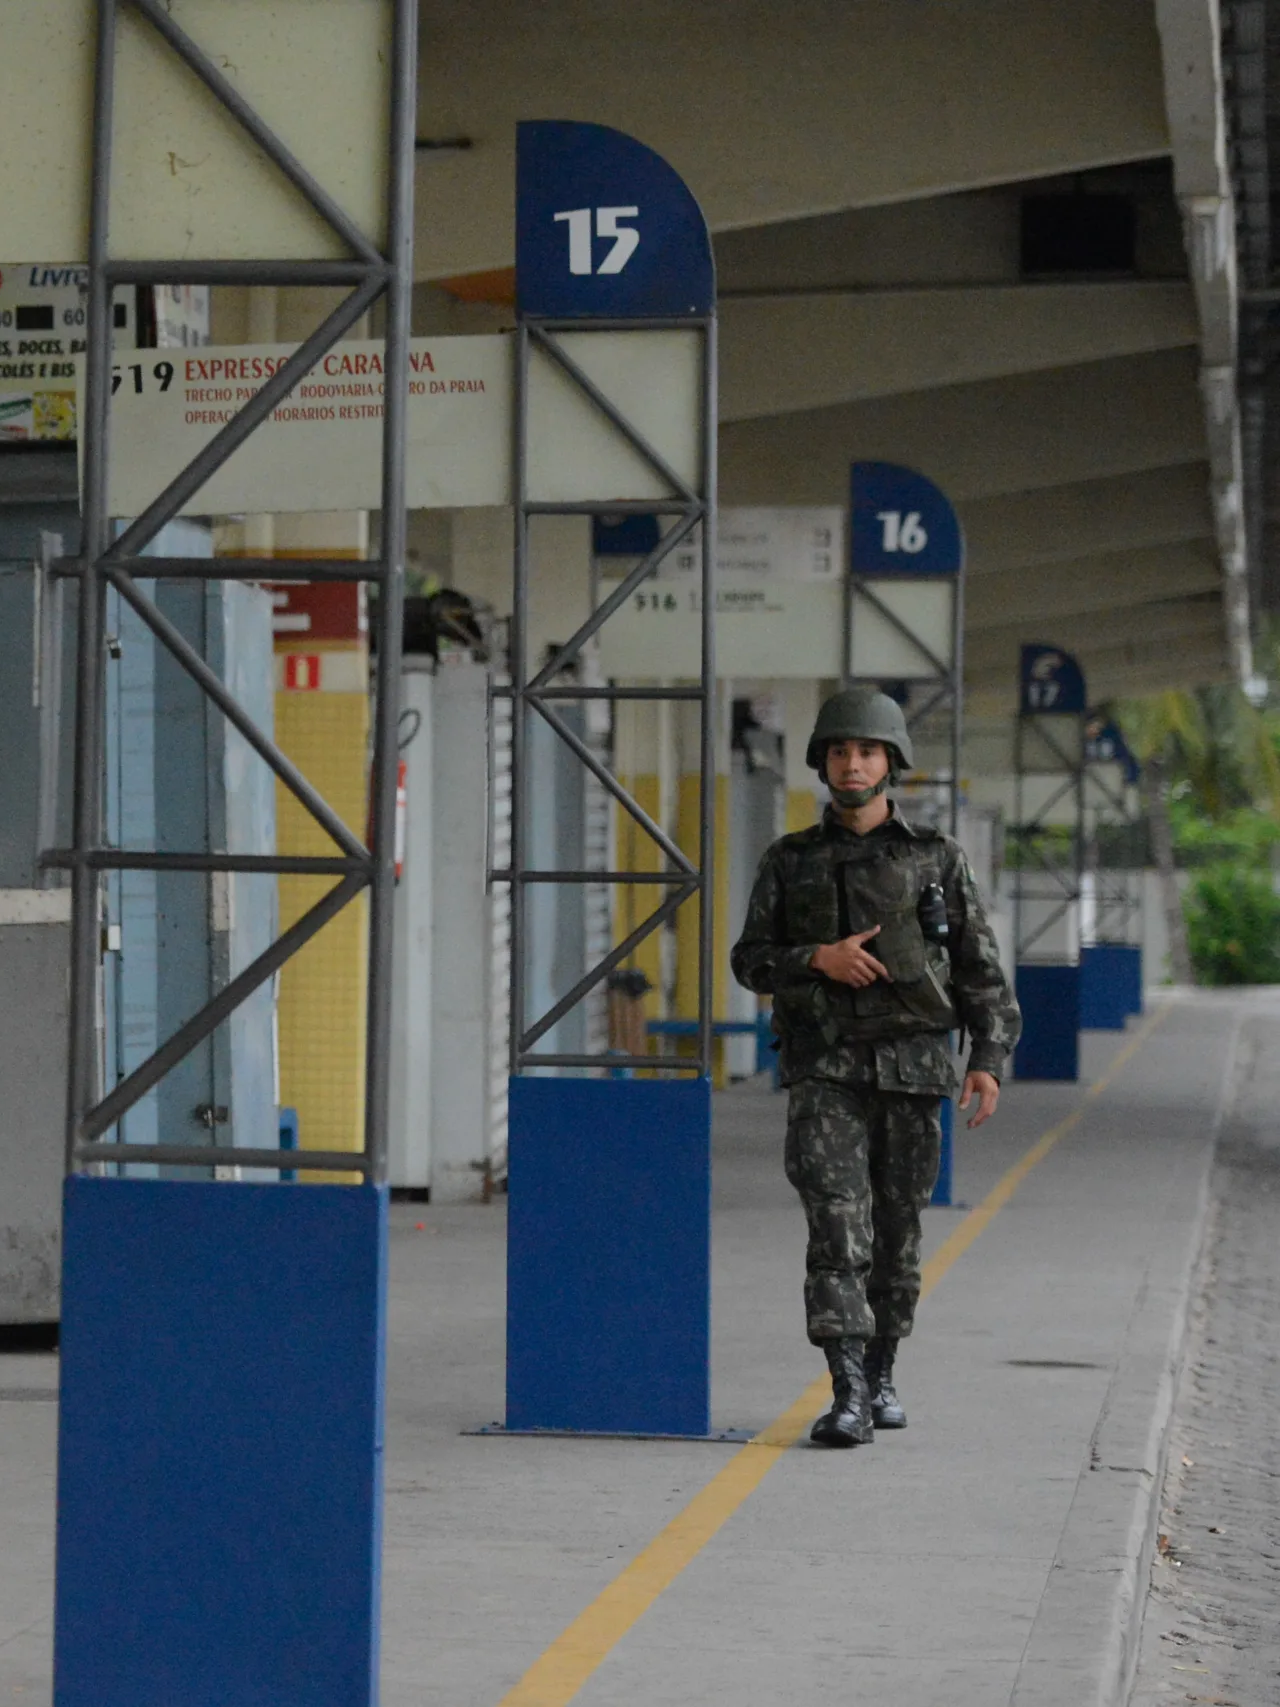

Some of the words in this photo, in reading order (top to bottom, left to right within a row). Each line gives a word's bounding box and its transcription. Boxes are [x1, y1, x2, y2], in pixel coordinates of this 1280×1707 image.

[553, 206, 640, 275] 15
[63, 307, 85, 326] 60
[324, 352, 436, 377] CARANA
[185, 387, 232, 402] TRECHO
[429, 381, 446, 395] DA
[450, 379, 486, 394] PRAIA
[875, 510, 928, 554] 16
